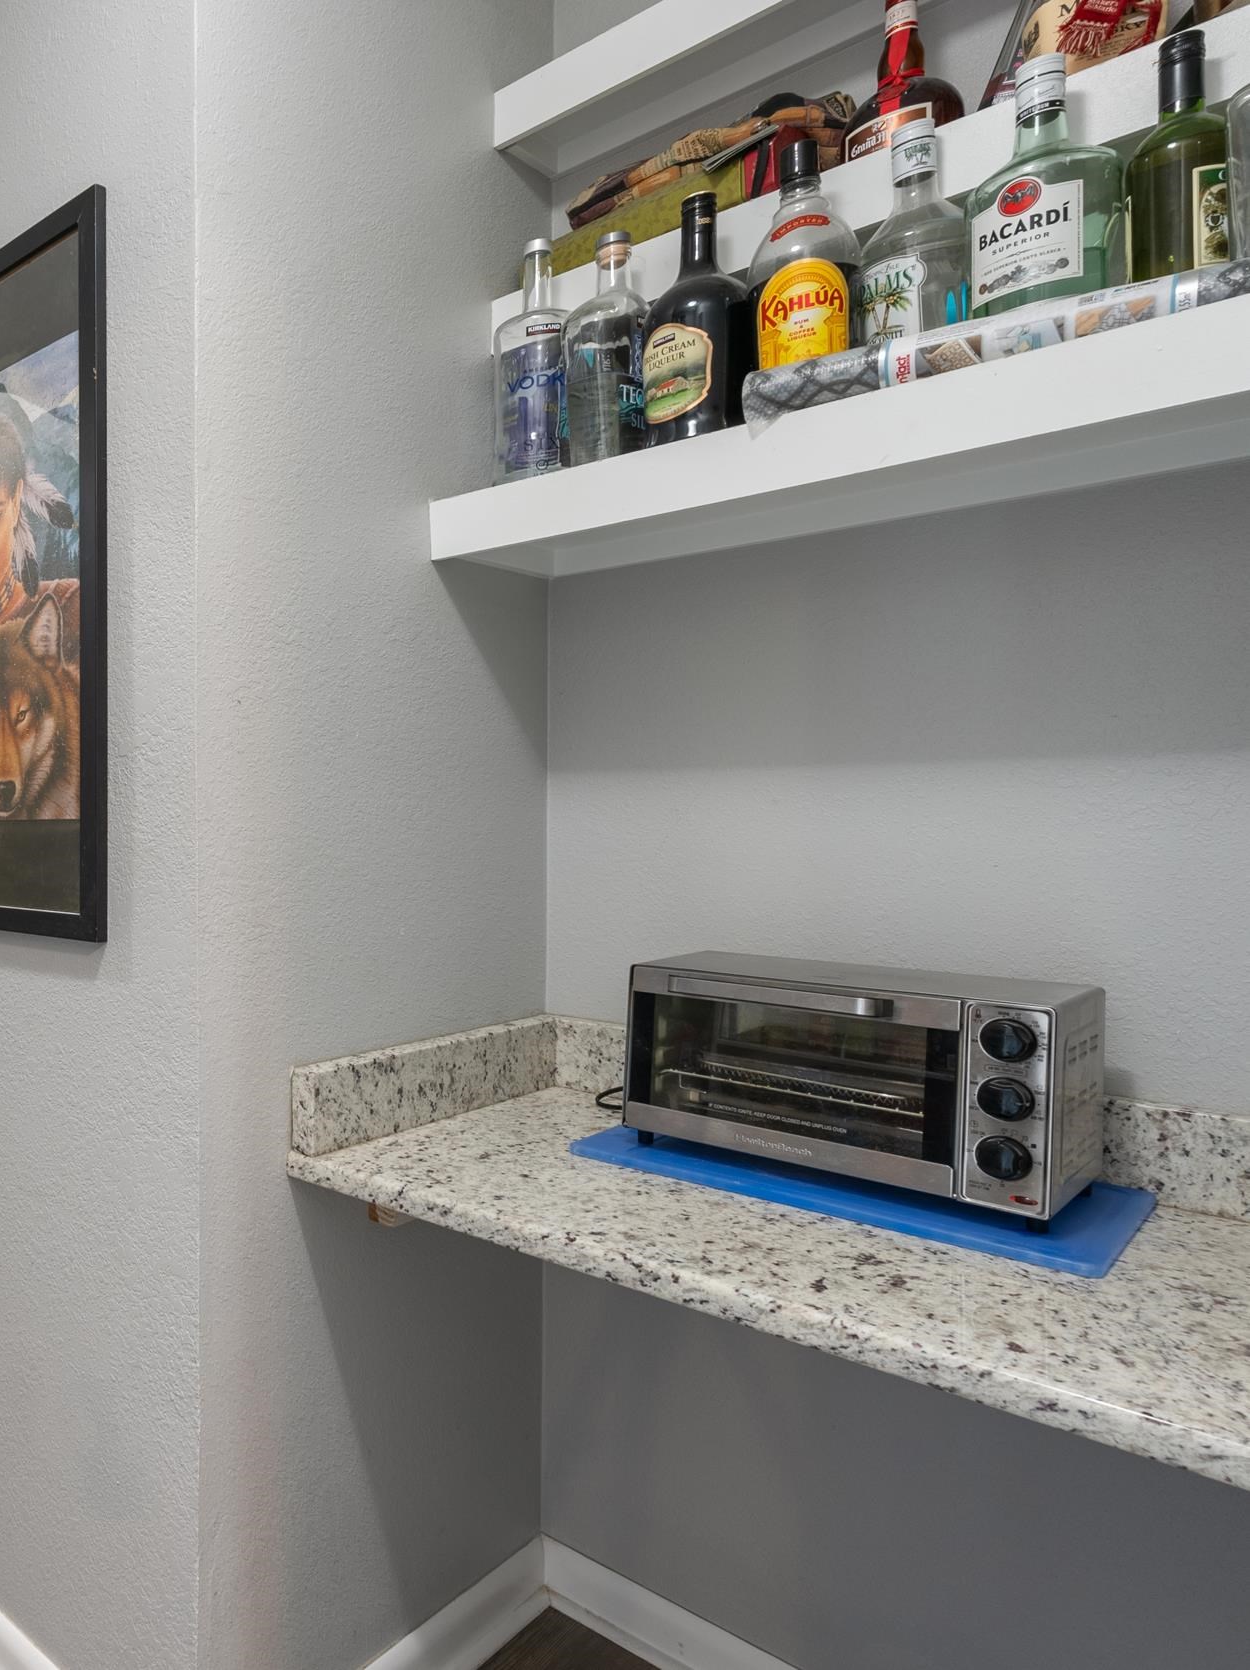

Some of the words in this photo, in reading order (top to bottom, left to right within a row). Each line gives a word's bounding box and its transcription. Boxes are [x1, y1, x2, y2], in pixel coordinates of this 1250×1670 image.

[979, 200, 1070, 251] BACARDÍ
[991, 231, 1050, 255] SUPERIOR
[760, 285, 845, 331] KAHLÚA
[527, 323, 561, 332] KIRKLAND
[661, 339, 697, 356] CREAM
[649, 352, 685, 371] LIQUEUR
[508, 373, 566, 393] VODK
